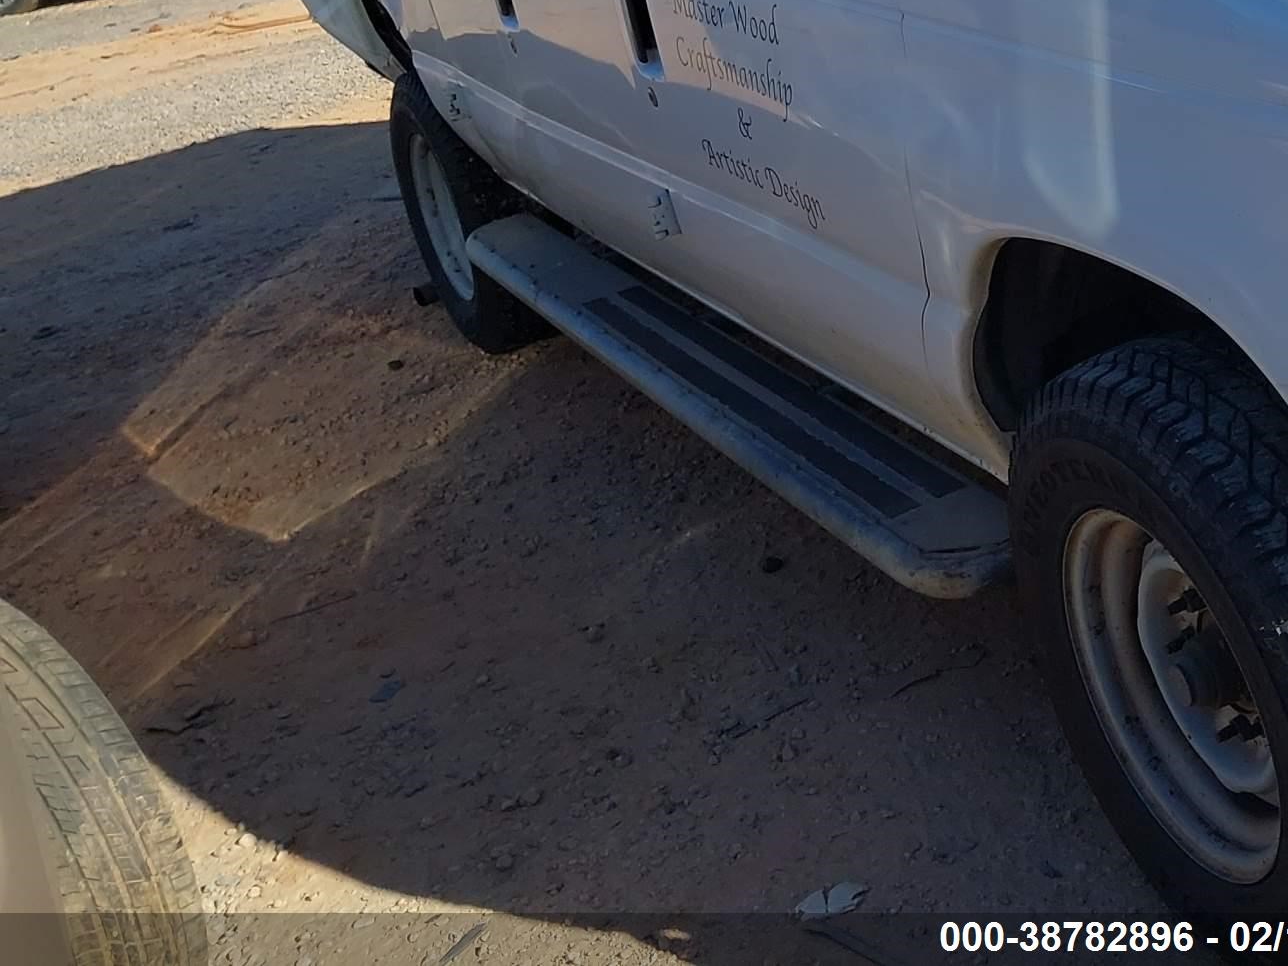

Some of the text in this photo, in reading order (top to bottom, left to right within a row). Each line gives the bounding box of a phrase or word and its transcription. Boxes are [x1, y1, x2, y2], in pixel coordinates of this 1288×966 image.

[729, 0, 780, 45] Wood
[676, 36, 793, 122] Craftsmanship
[737, 107, 753, 140] &
[701, 138, 826, 229] Artistic Design
